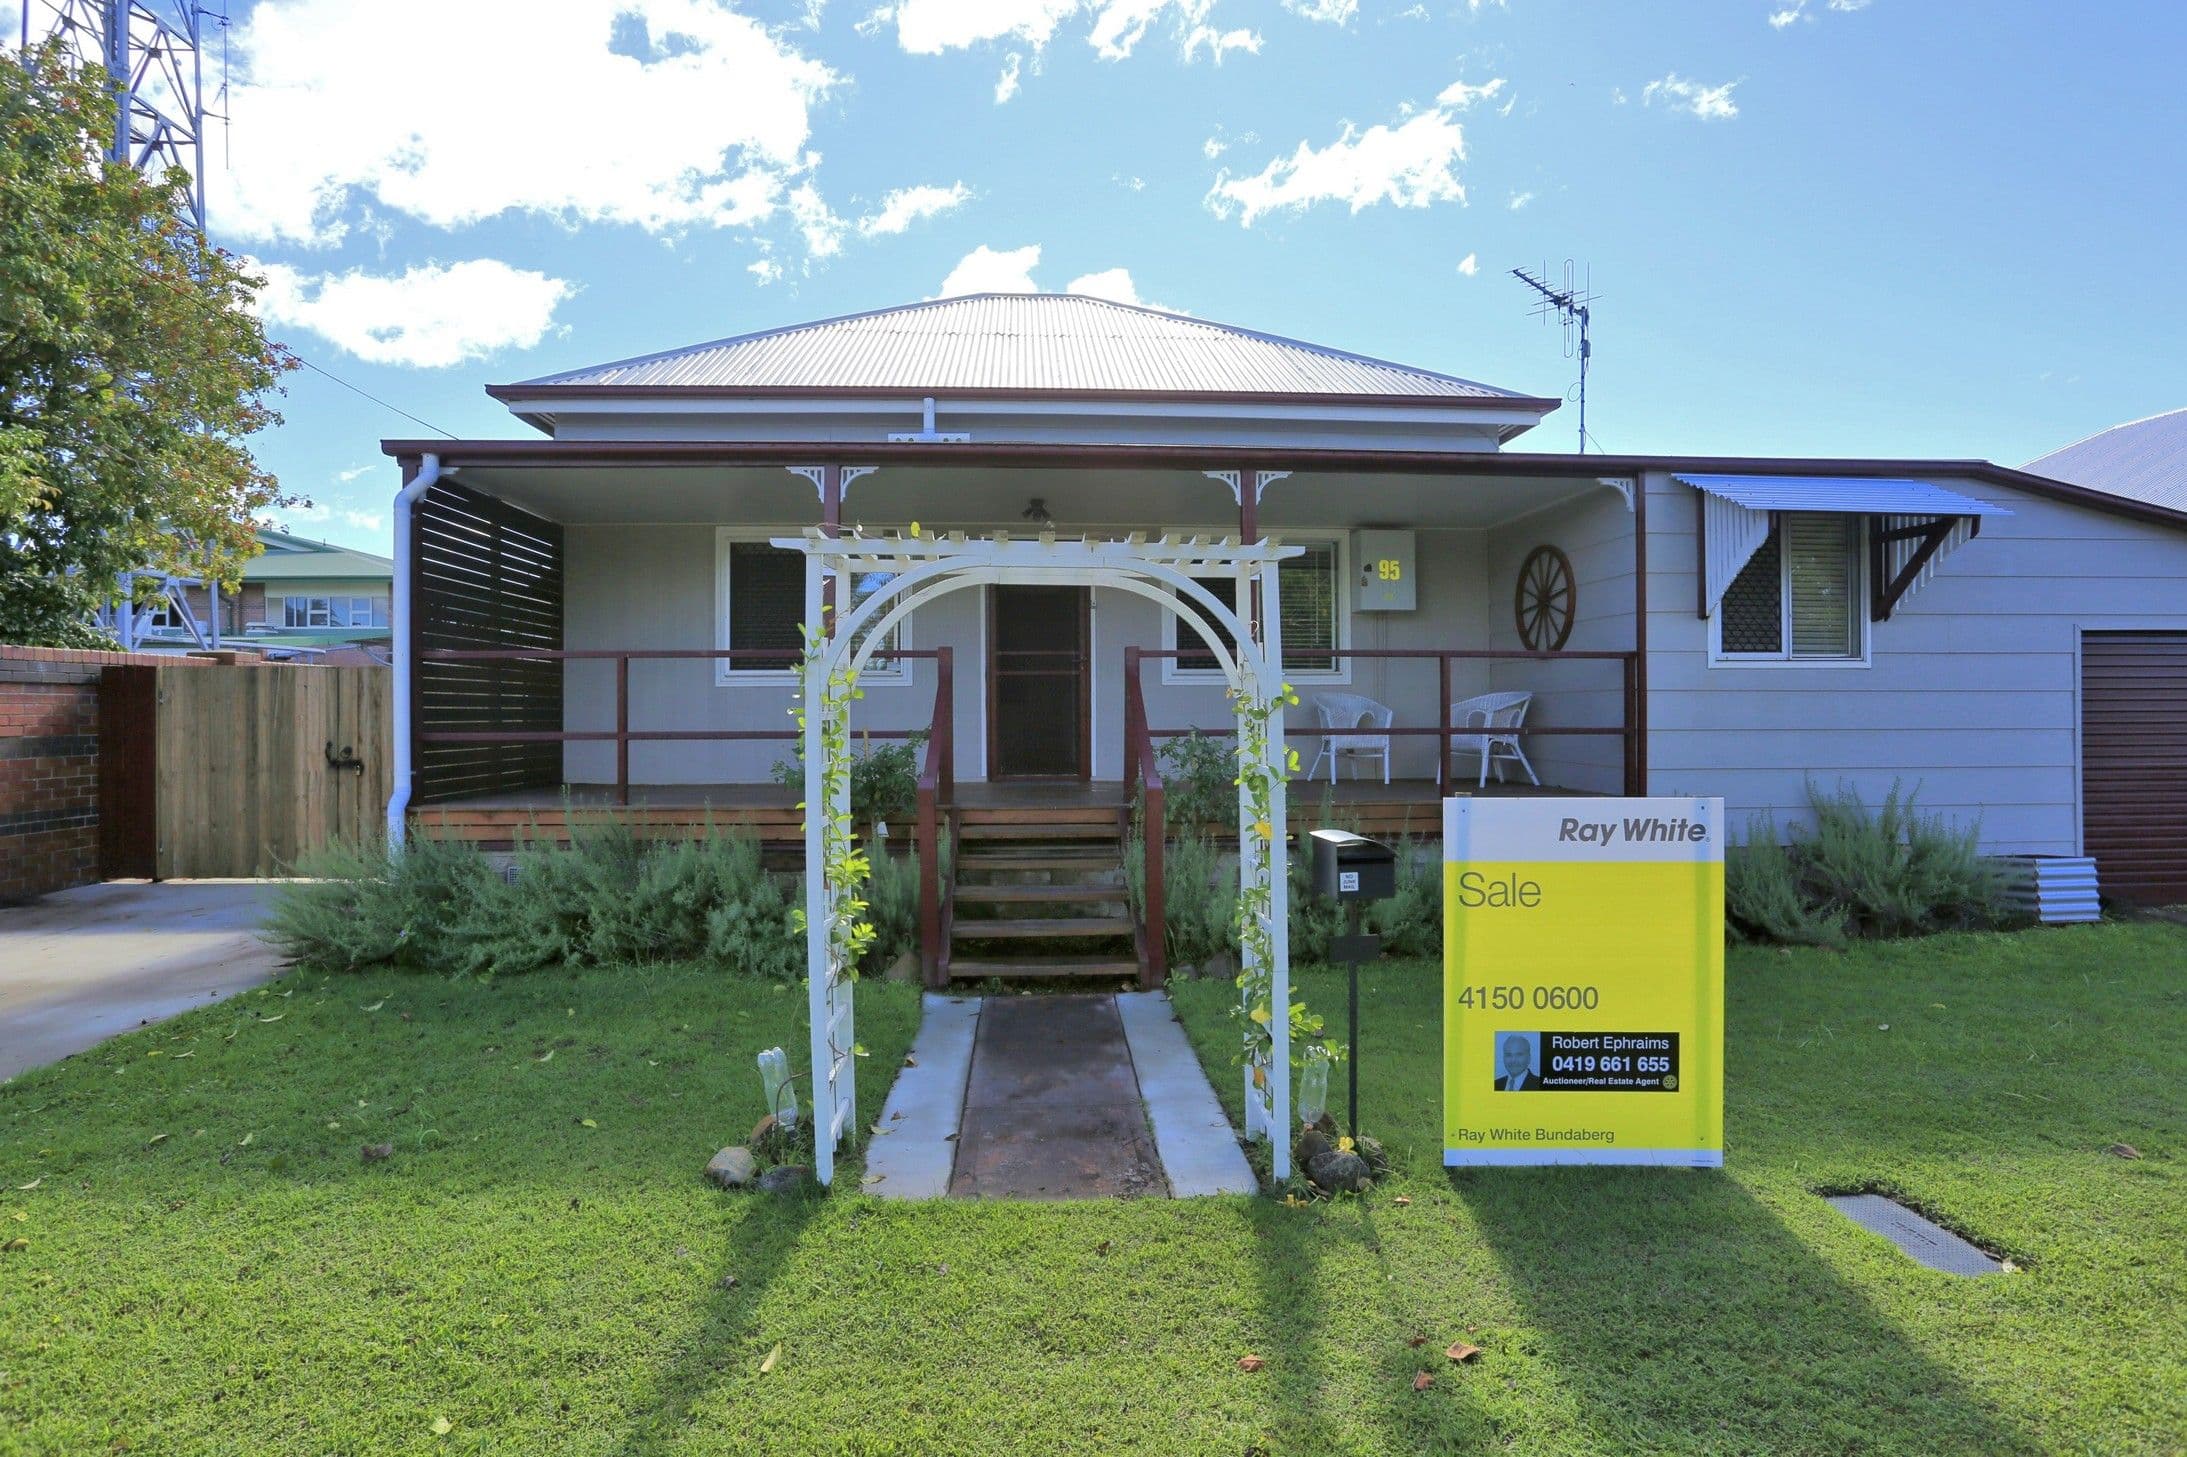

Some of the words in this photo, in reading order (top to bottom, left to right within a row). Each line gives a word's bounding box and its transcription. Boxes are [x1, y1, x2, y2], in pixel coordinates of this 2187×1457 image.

[1378, 559, 1401, 581] 95
[1558, 817, 1617, 846] Ray
[1623, 817, 1707, 842] White
[1458, 871, 1542, 908] Sale
[1458, 986, 1525, 1010] 4150
[1532, 986, 1599, 1010] 0600
[1552, 1035, 1600, 1050] Robert
[1603, 1035, 1670, 1052] Ephraims
[1552, 1056, 1595, 1072] 0419
[1599, 1056, 1631, 1072] 661
[1637, 1056, 1670, 1072] 655
[1542, 1076, 1606, 1087] Auctioneer/Real
[1608, 1077, 1634, 1086] Estate
[1635, 1077, 1660, 1087] Agent
[1458, 1128, 1486, 1144] Ray
[1490, 1128, 1531, 1142] White
[1535, 1128, 1615, 1144] Bundaberg
